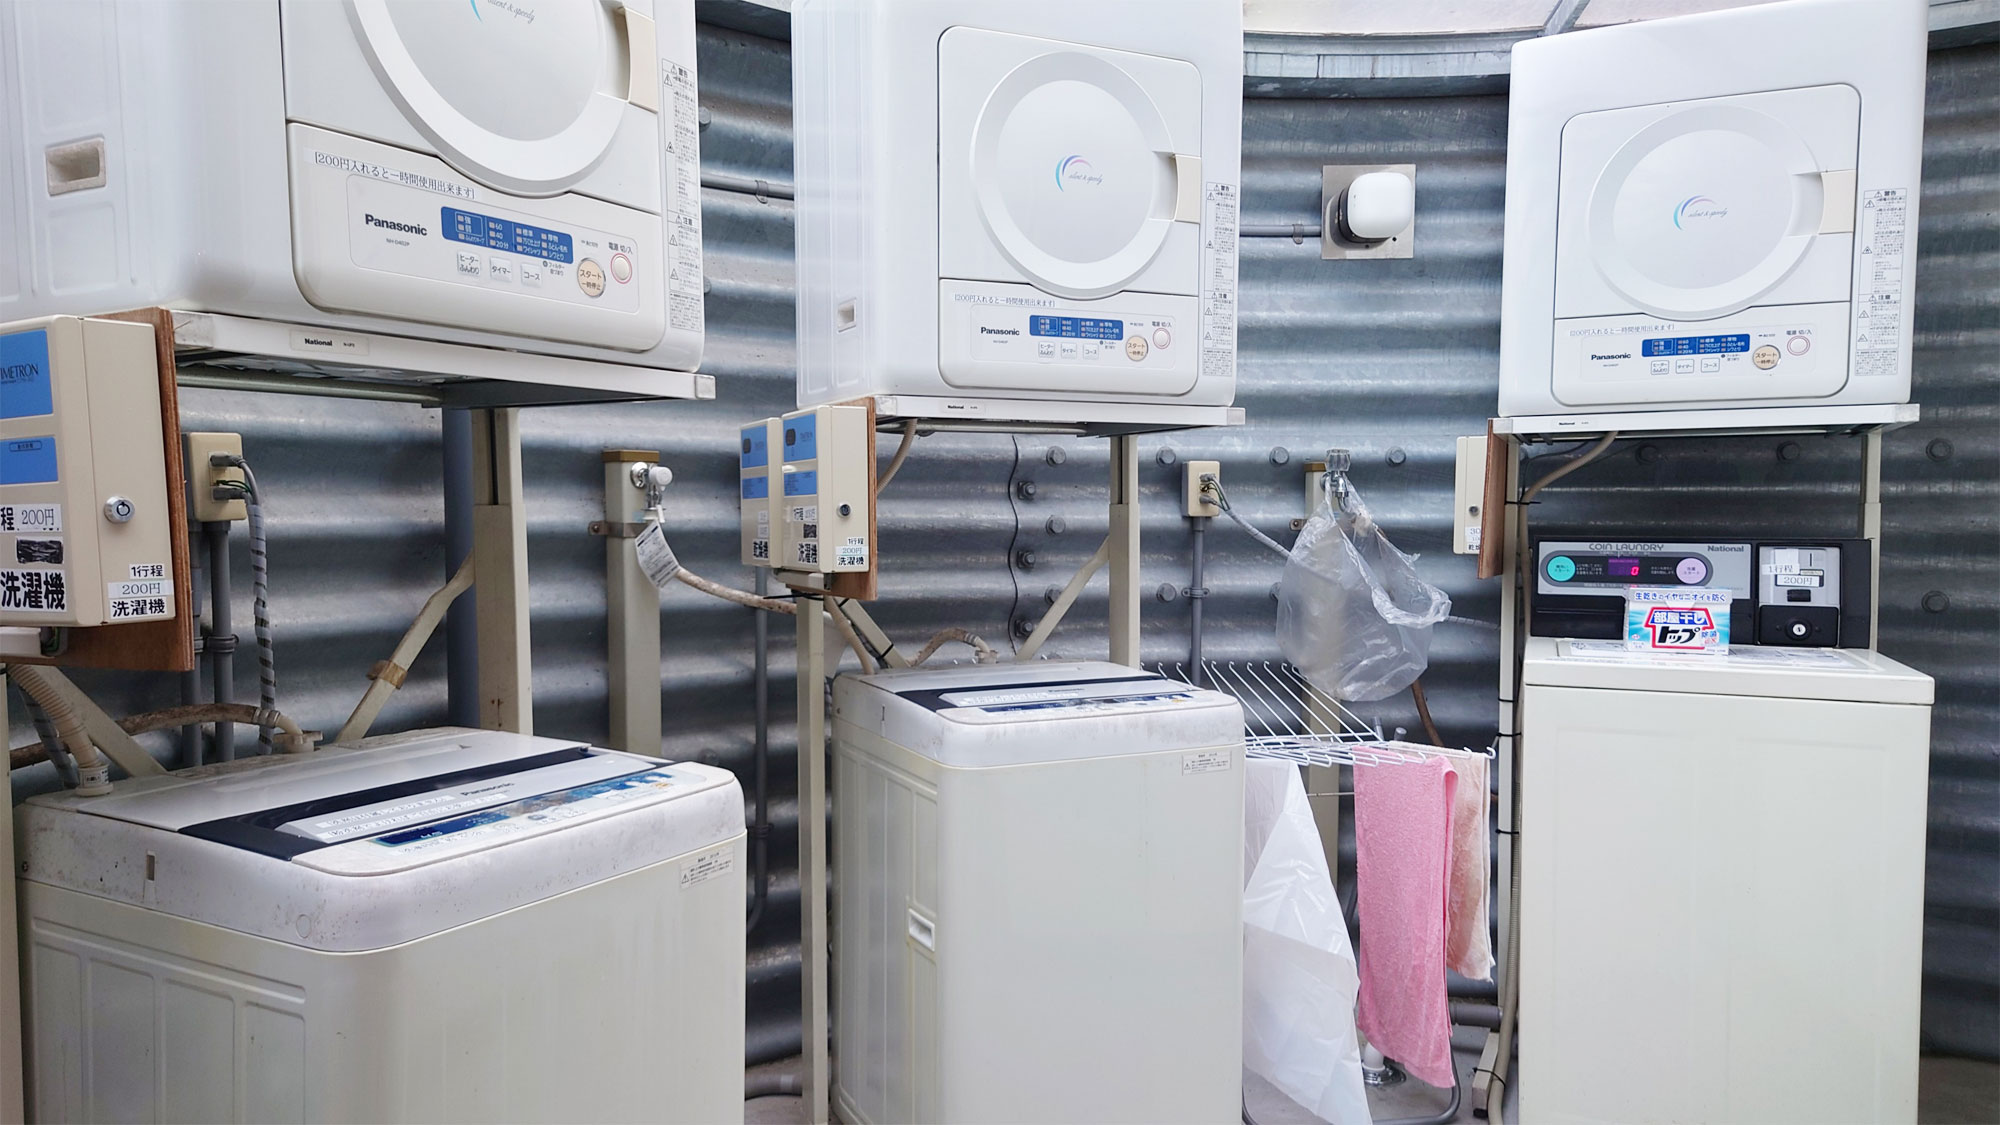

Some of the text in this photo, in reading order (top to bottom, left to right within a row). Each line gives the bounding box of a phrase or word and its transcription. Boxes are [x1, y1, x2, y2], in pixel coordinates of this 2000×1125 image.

[365, 213, 428, 236] Panasonic
[495, 223, 503, 231] 60
[496, 241, 509, 249] 20分
[608, 242, 618, 251] 電源
[460, 255, 479, 263] ヒーター
[460, 264, 479, 274] ふんわり
[491, 266, 511, 274] タイマー
[523, 271, 541, 280] コース
[580, 269, 602, 280] スタート
[582, 281, 601, 291] 一時停止
[981, 326, 1020, 336] Panasonic
[304, 338, 333, 346] National
[0, 506, 55, 531] 程 200円
[1589, 543, 1664, 551] COIN LAUNDRY
[838, 557, 864, 565] 洗濯機
[131, 564, 163, 577] 1行程
[1630, 566, 1640, 576] 0
[1769, 565, 1793, 573] 1行程
[1784, 576, 1813, 584] 200円
[0, 571, 65, 610] 洗濯機
[122, 582, 160, 595] 200円
[1635, 592, 1726, 601] 生乾きのイヤなニオイを防ぐ
[112, 598, 165, 617] 洗濯機
[1654, 612, 1705, 624] 部屋干し
[1658, 626, 1701, 644] トップ
[460, 783, 514, 796] Panasonic
